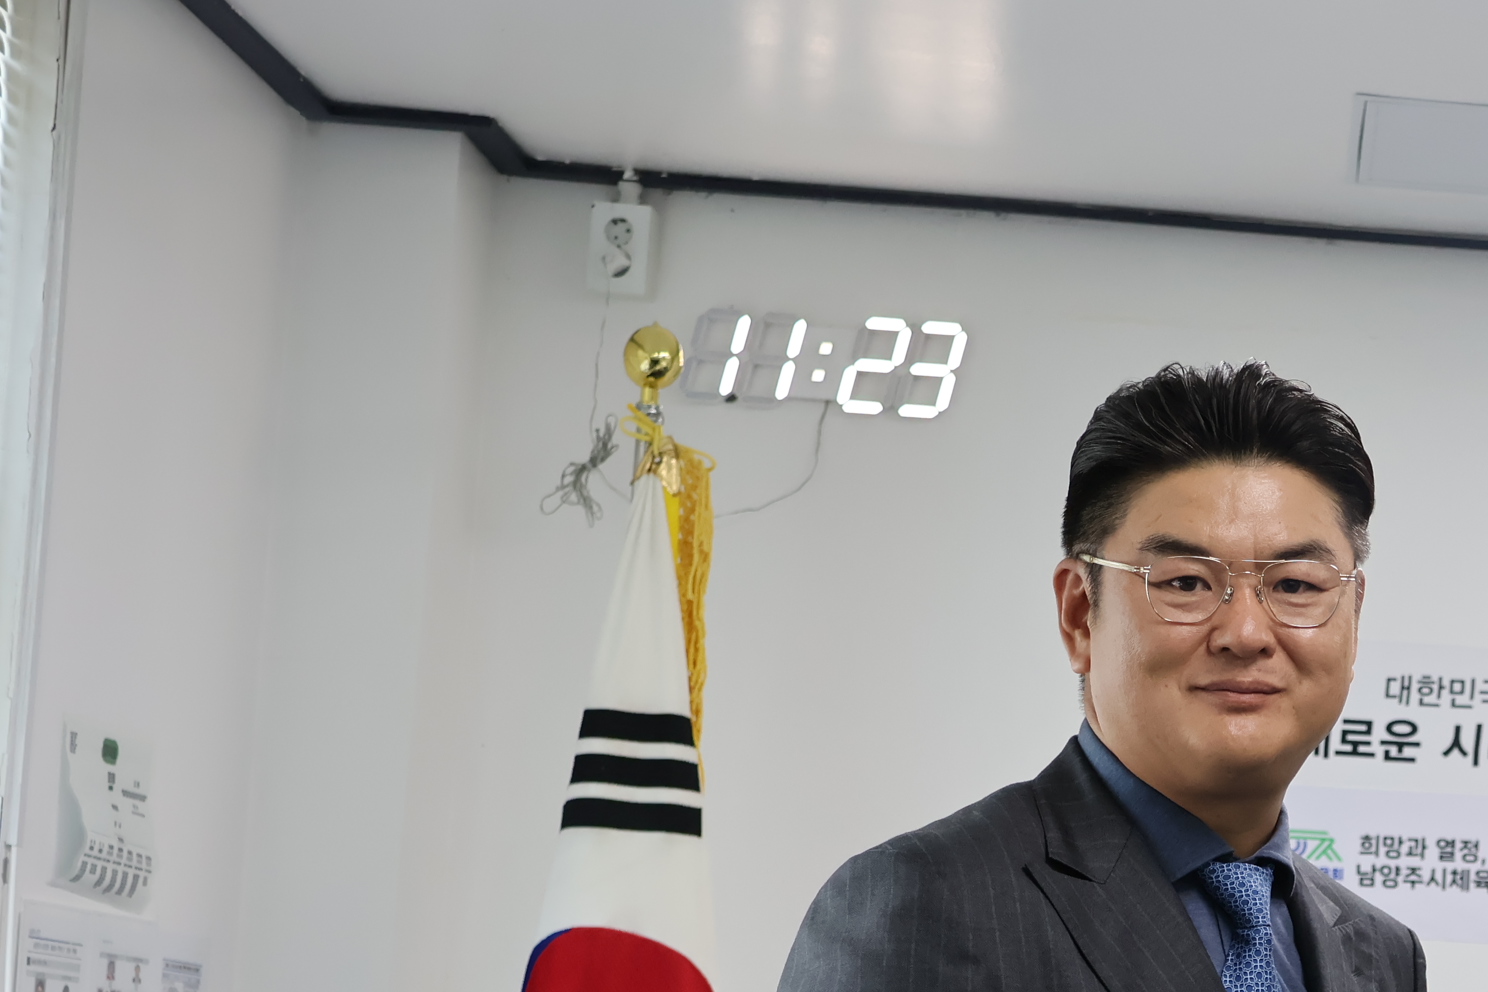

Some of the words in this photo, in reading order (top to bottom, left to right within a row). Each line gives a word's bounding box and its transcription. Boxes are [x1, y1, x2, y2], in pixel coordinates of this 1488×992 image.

[718, 313, 968, 419] 11:23
[1314, 718, 1422, 763] 로운
[1359, 834, 1428, 861] 희망과
[1436, 838, 1485, 866] 열정,
